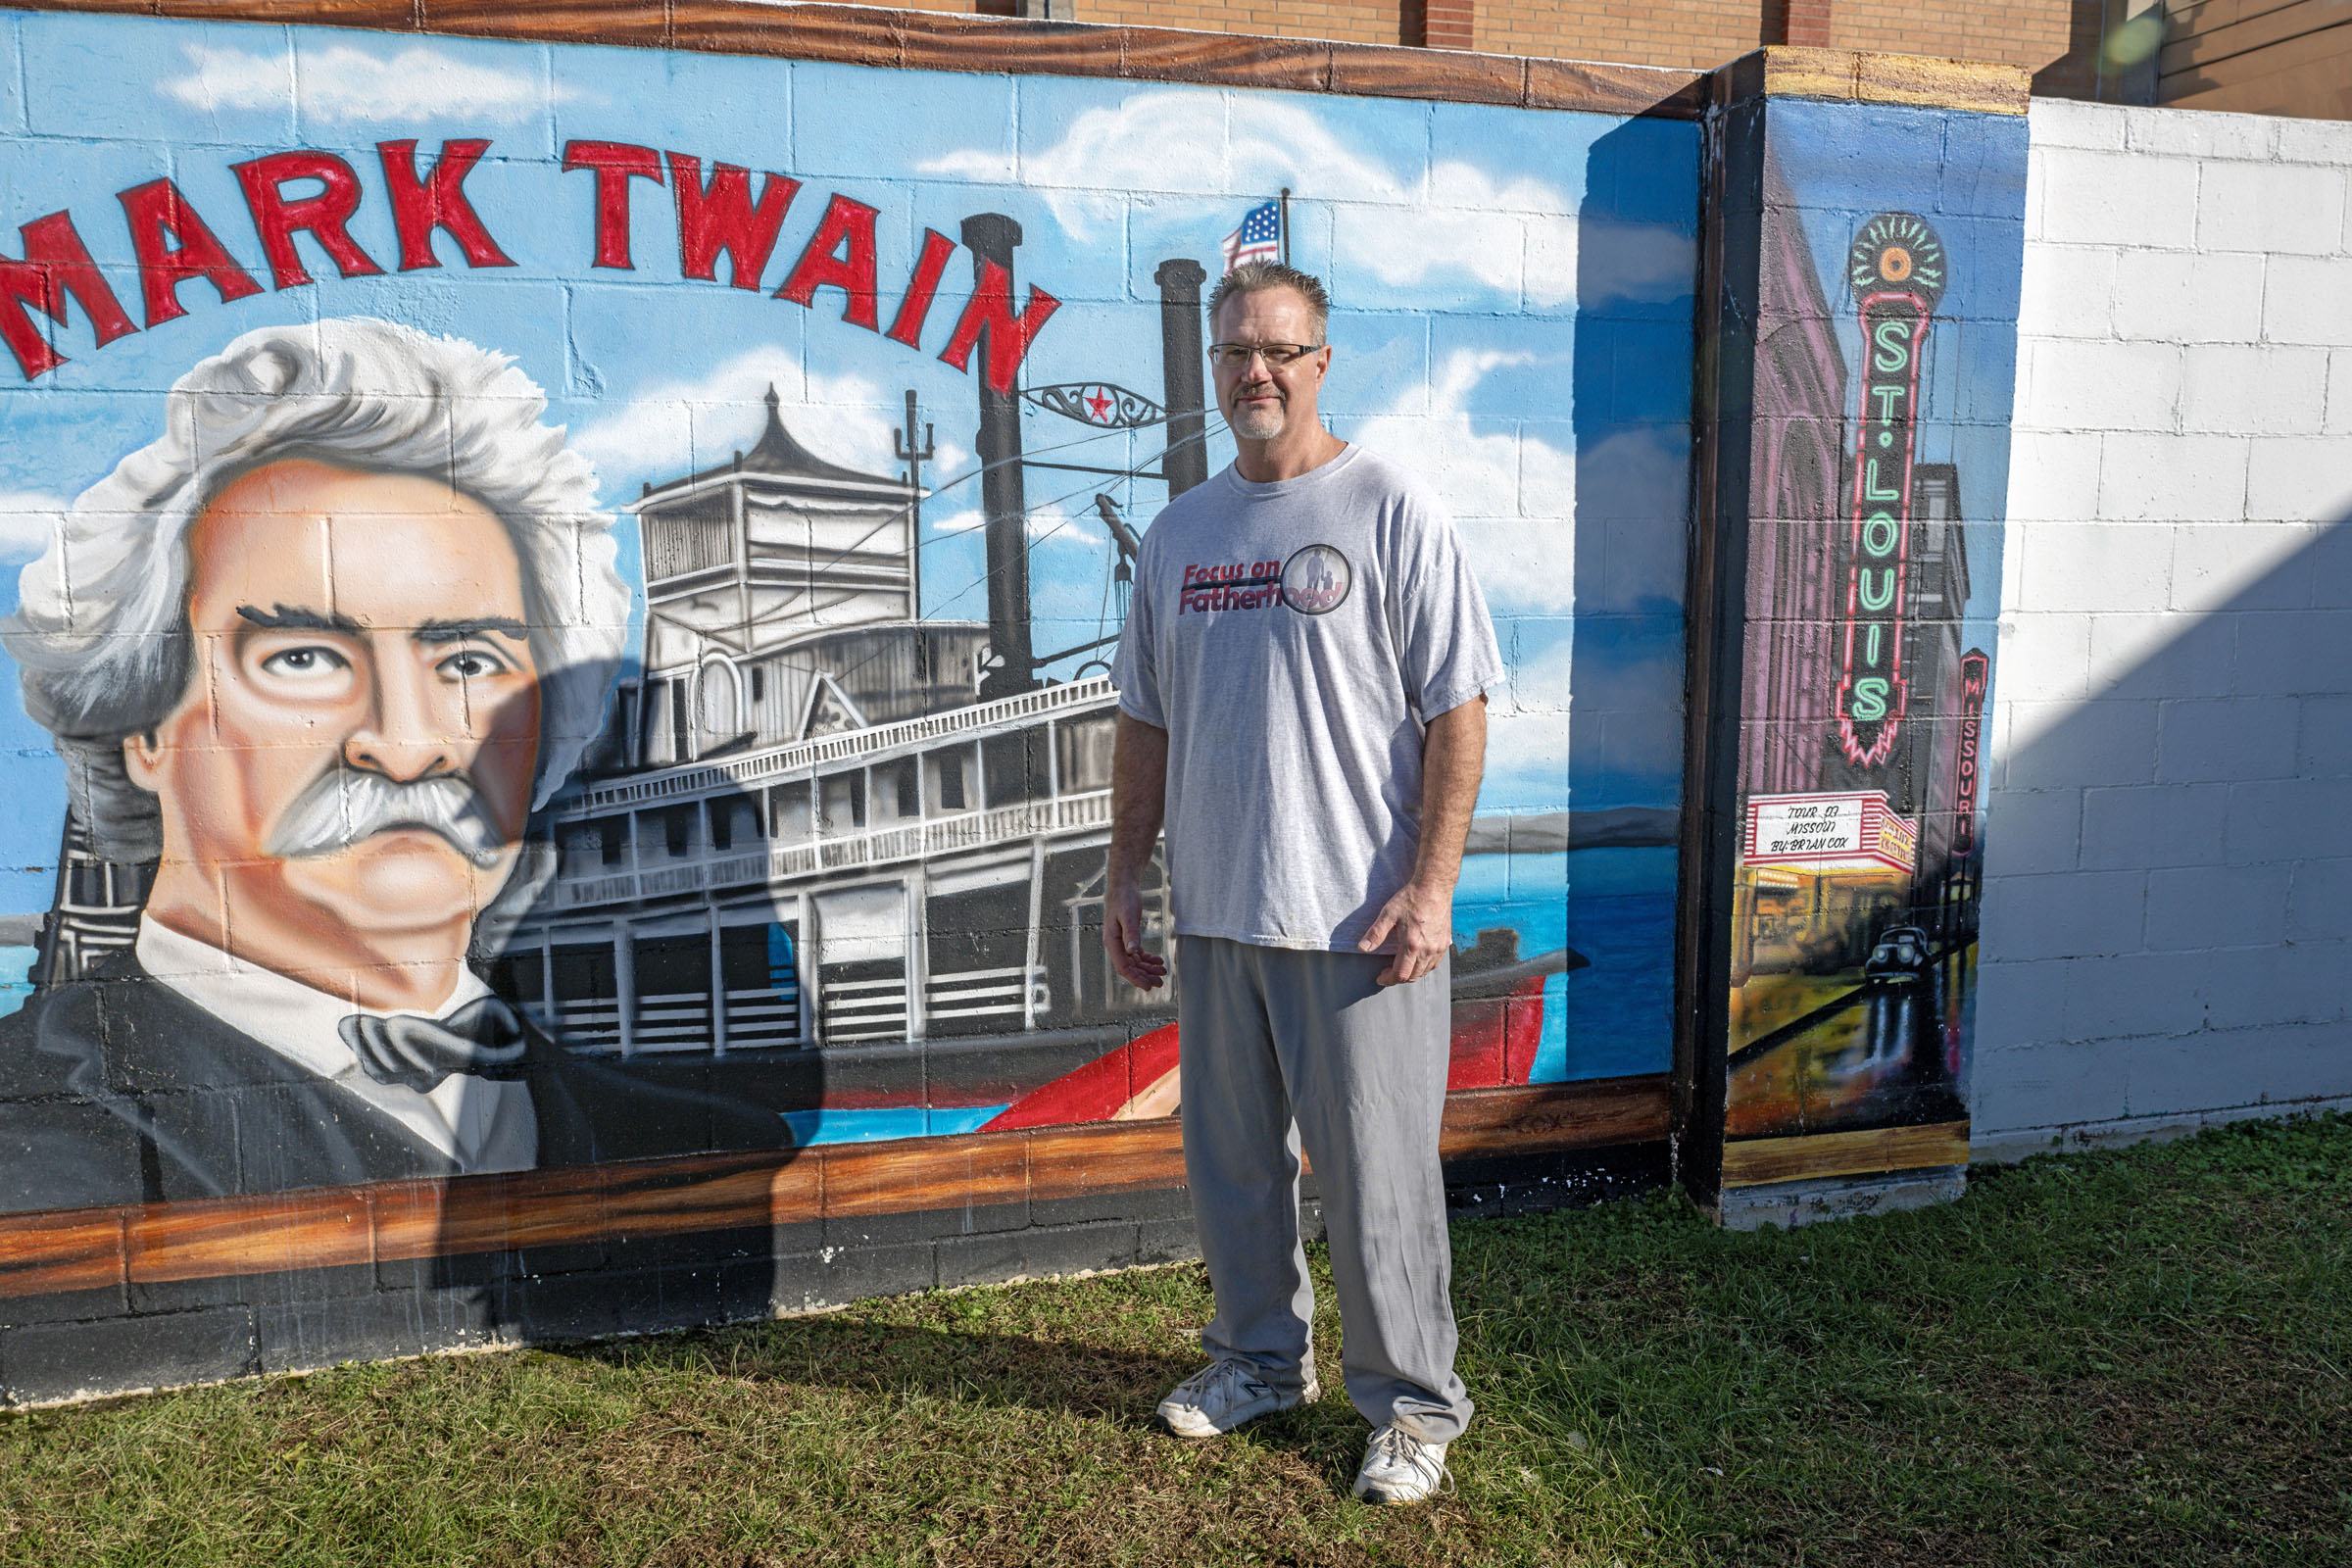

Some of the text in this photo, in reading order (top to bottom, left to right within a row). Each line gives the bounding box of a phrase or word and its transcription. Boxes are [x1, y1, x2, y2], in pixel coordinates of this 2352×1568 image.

[0, 139, 1062, 398] MARK TWAIN
[1183, 560, 1281, 586] Focus on
[1852, 459, 1899, 721] LOUIS
[1959, 678, 1980, 835] MISSOURI
[1788, 806, 1818, 819] TOUR
[1791, 838, 1826, 852] BRIAN
[1828, 836, 1849, 849] COX
